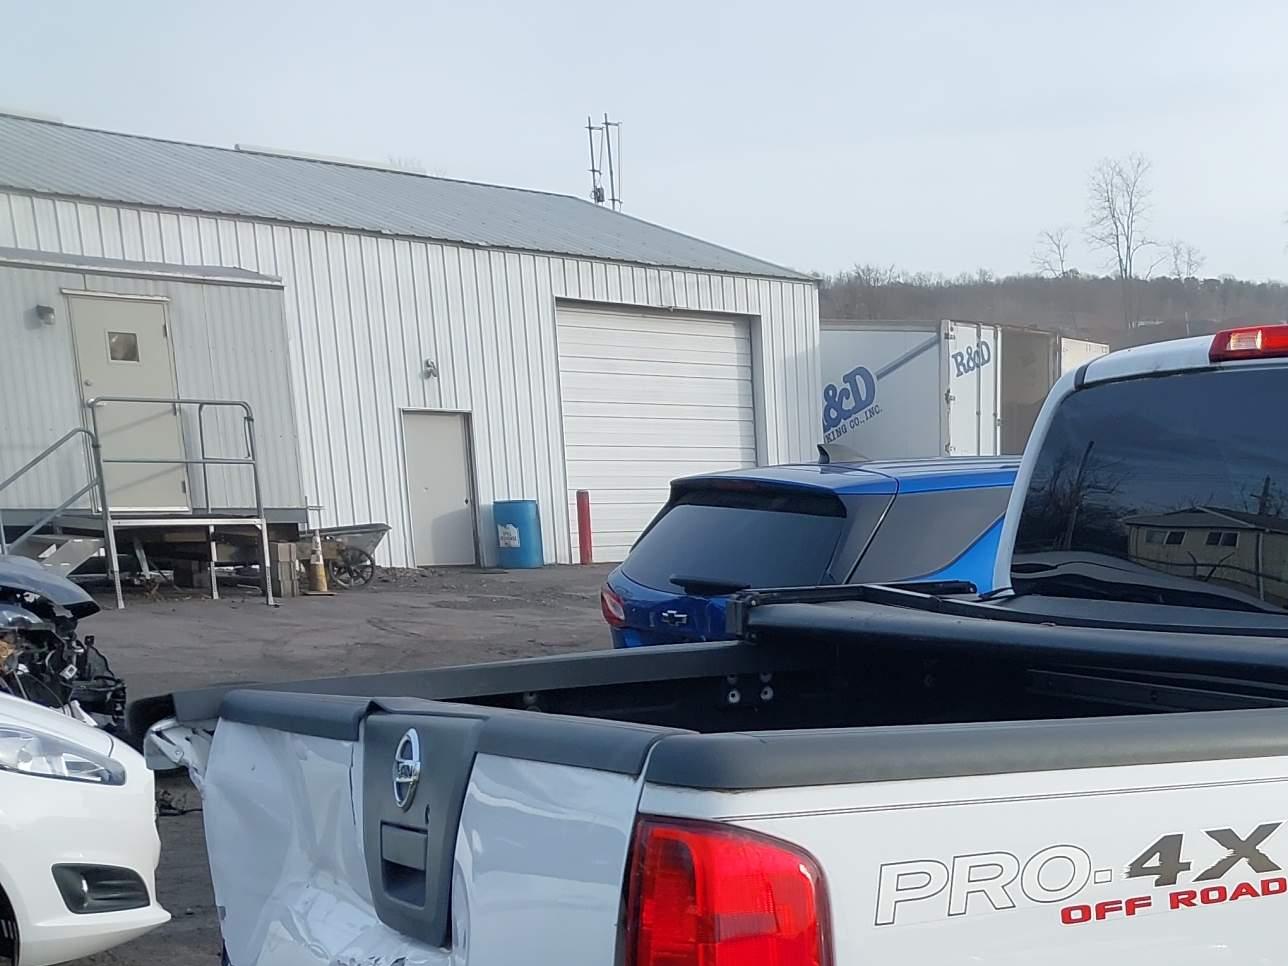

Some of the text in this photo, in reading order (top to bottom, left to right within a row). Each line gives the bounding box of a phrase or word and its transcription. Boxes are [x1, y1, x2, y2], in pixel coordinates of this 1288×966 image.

[952, 340, 991, 378] R&D
[822, 366, 876, 433] &D
[825, 422, 848, 443] KING
[1060, 876, 1288, 925] OFF ROAD
